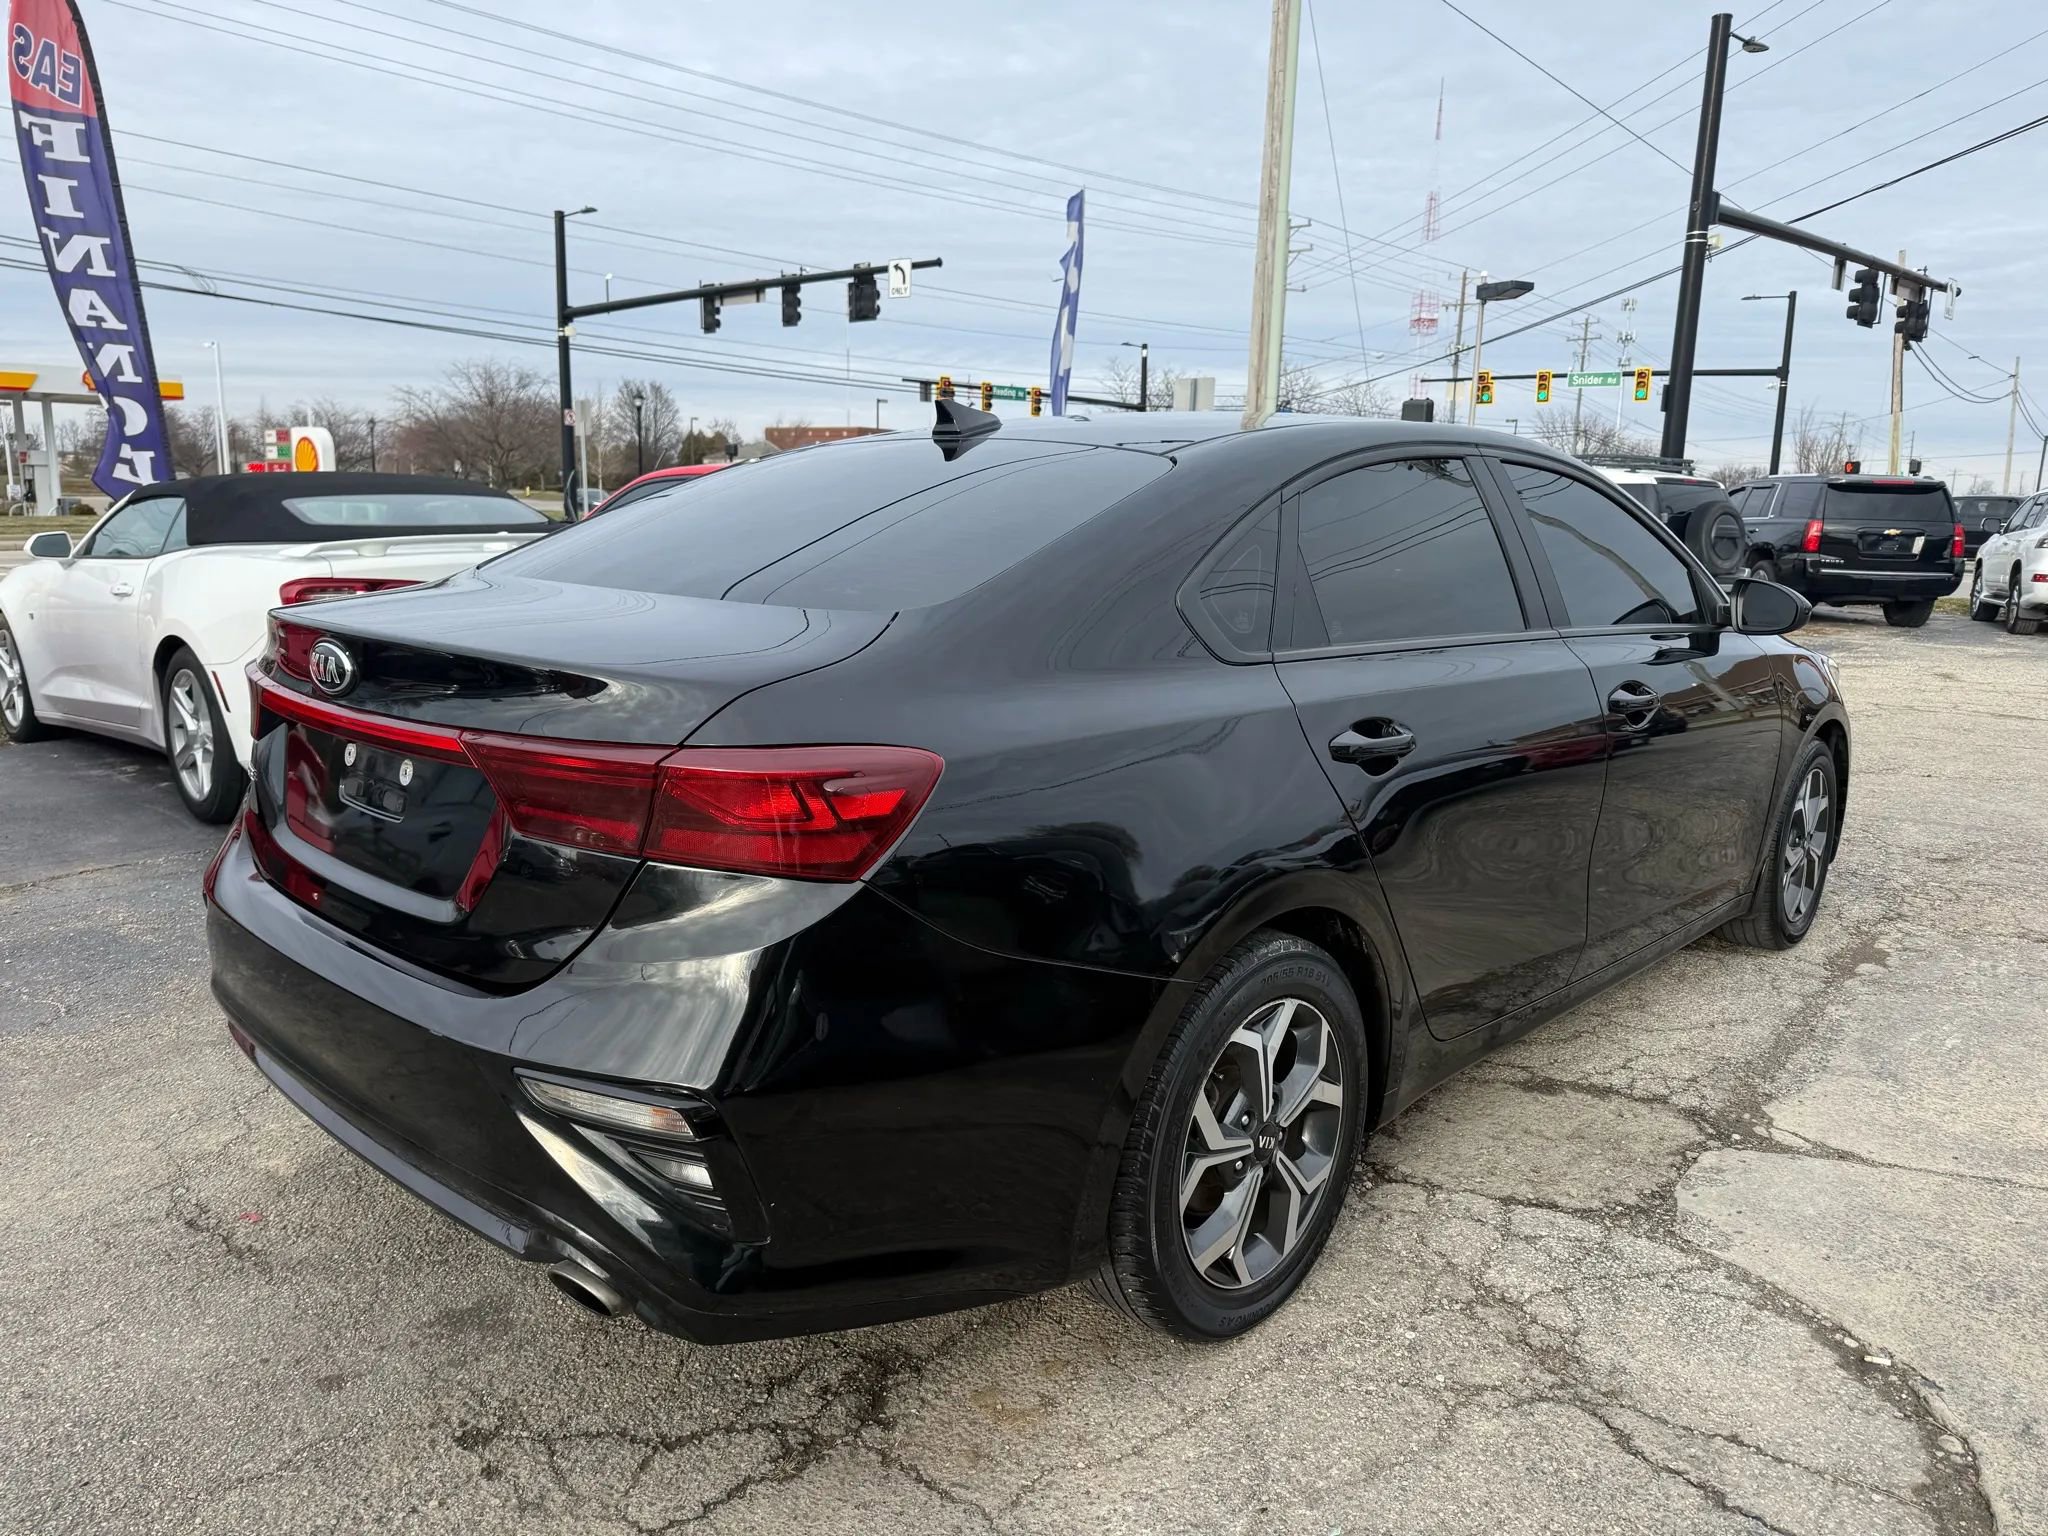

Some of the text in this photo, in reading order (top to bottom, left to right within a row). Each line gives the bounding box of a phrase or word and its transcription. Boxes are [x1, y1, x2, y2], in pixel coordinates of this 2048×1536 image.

[891, 286, 908, 296] ONLY
[1572, 375, 1603, 385] Snider
[311, 652, 340, 684] KIA
[1259, 1135, 1276, 1149] KIA
